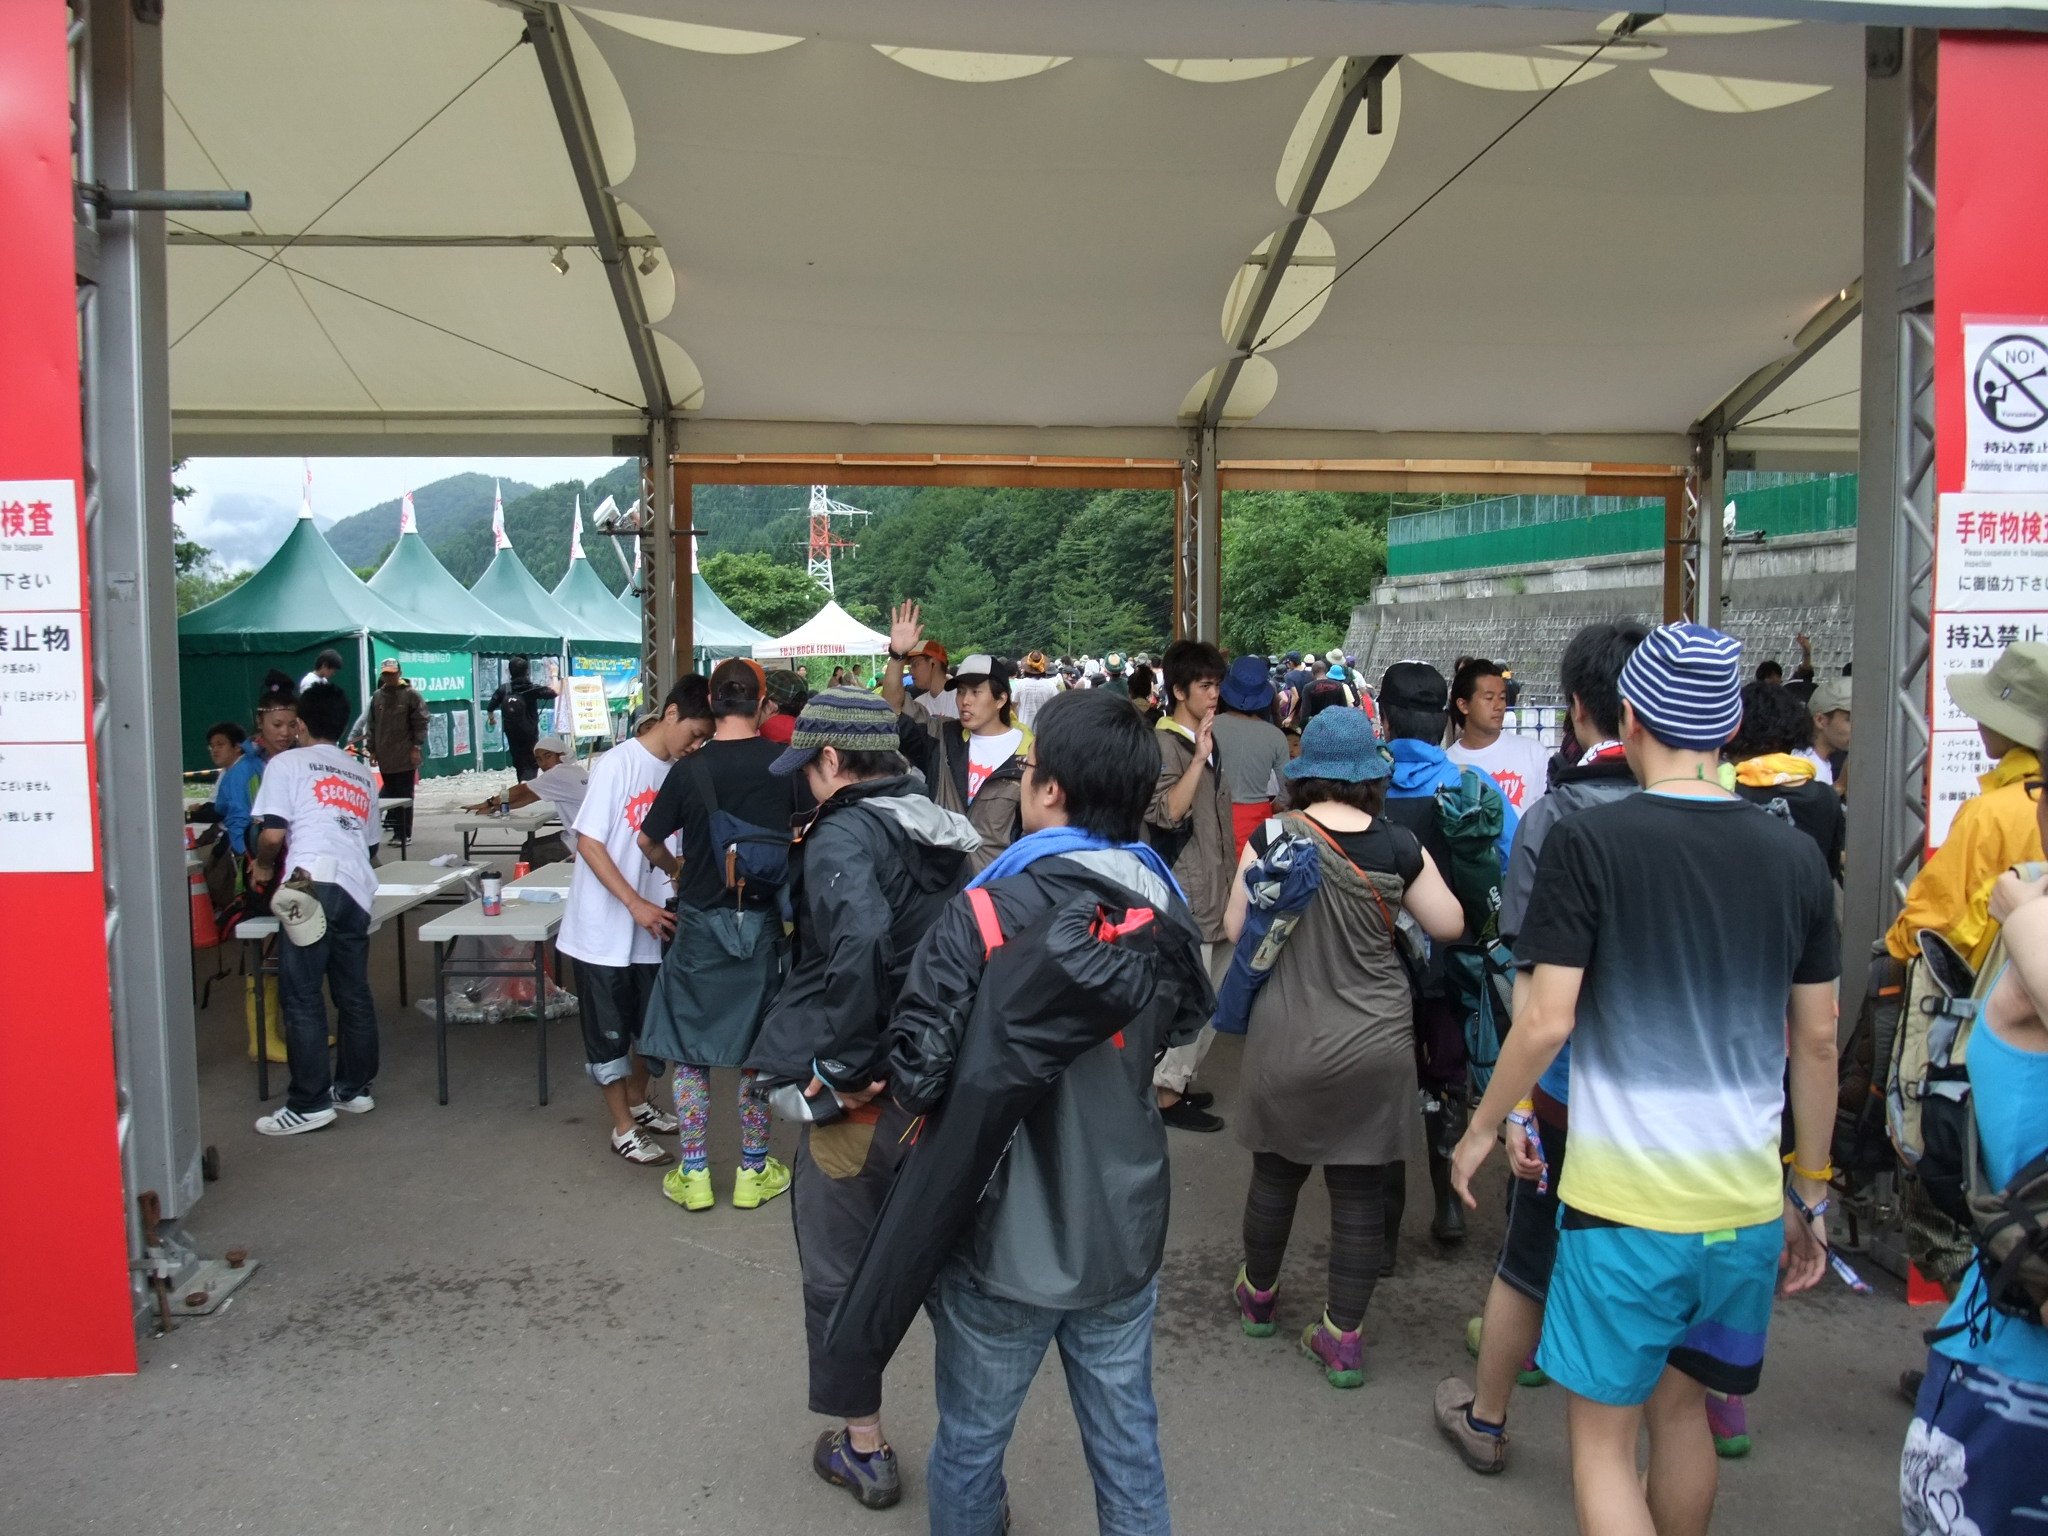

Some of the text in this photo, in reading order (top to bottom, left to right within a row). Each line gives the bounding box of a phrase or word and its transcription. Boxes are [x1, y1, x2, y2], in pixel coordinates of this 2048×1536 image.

[2005, 350, 2035, 364] NO!
[1, 499, 54, 537] 検査
[1956, 511, 2048, 544] 手荷物検
[0, 573, 51, 590] 下さい
[796, 645, 815, 655] ROCK
[816, 643, 846, 654] FESTIVAL
[428, 676, 465, 691] JAPAN
